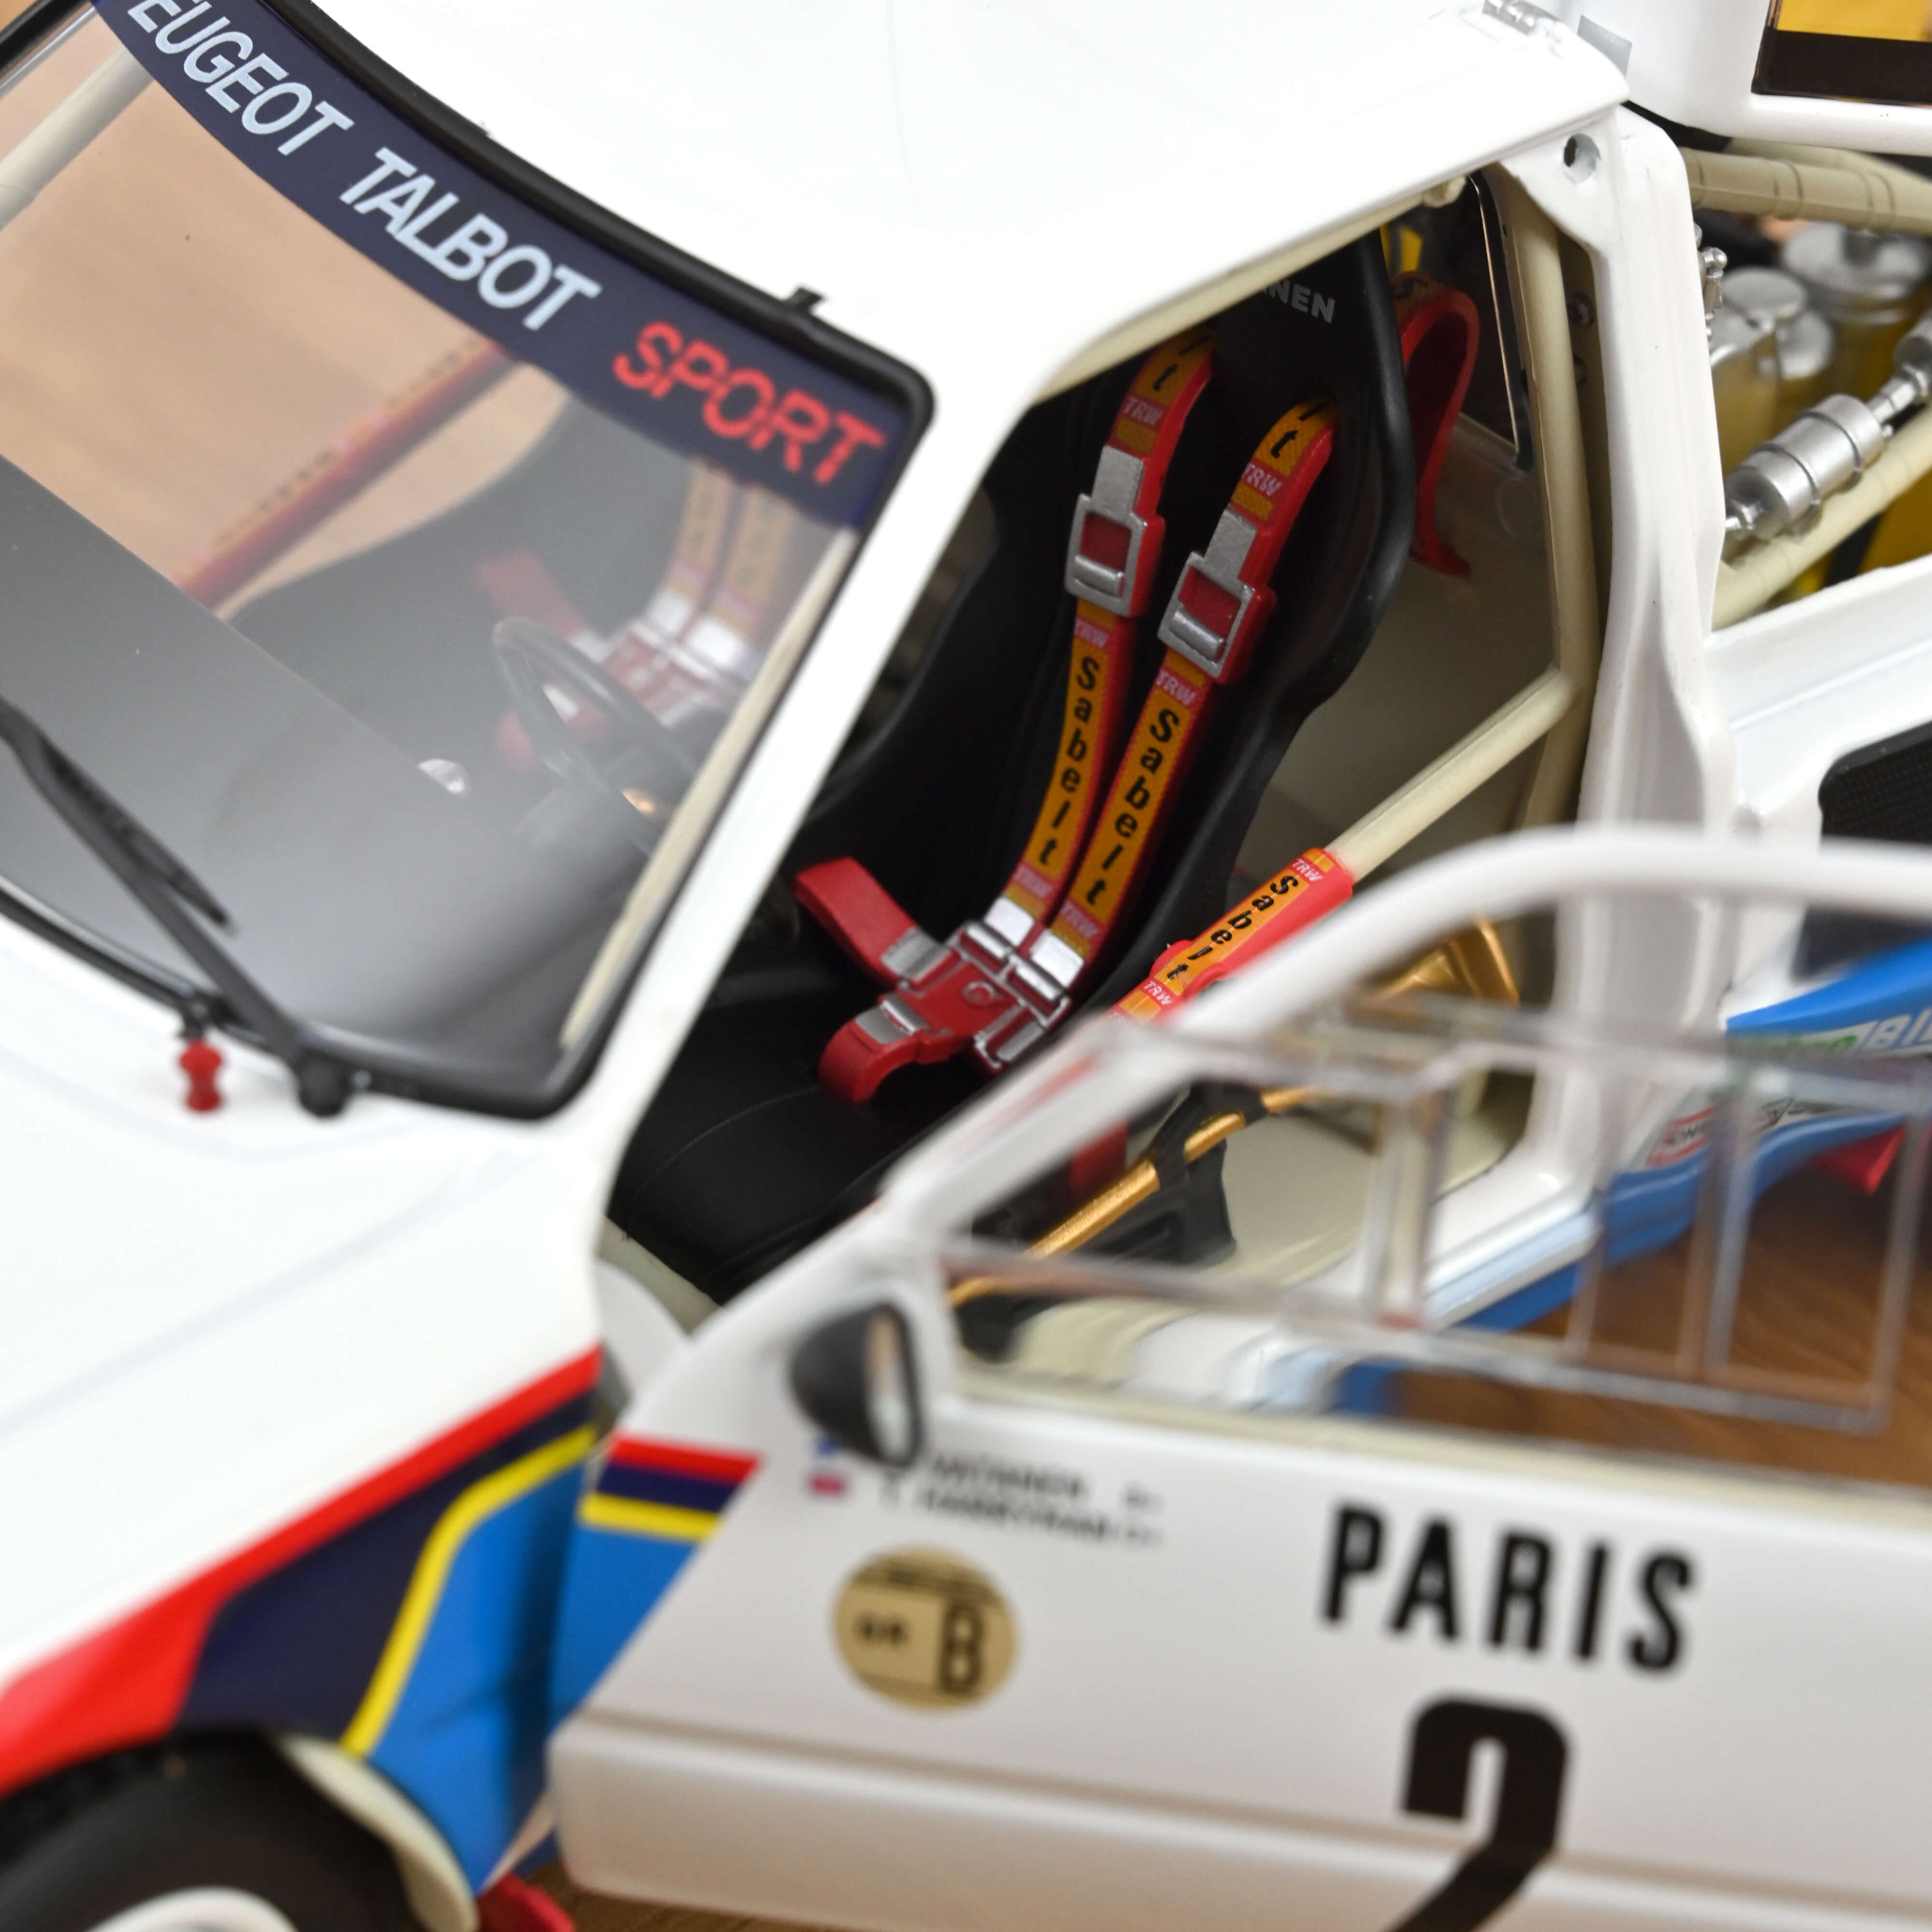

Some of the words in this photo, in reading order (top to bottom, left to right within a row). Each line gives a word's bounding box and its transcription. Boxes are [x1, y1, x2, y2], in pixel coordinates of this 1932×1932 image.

[340, 146, 602, 331] TALBOT
[612, 322, 886, 484] SPORT
[1262, 279, 1335, 323] NEN
[1122, 397, 1164, 426] TRW
[1241, 462, 1282, 497] TRW
[1156, 668, 1195, 705] TRW
[1038, 657, 1100, 866] Sabelt
[1086, 709, 1179, 905] Sabelt
[1292, 858, 1323, 881] TRW
[1166, 875, 1299, 980] Sabelt
[1144, 980, 1173, 1006] TRW
[1322, 1502, 1695, 1672] PARIS
